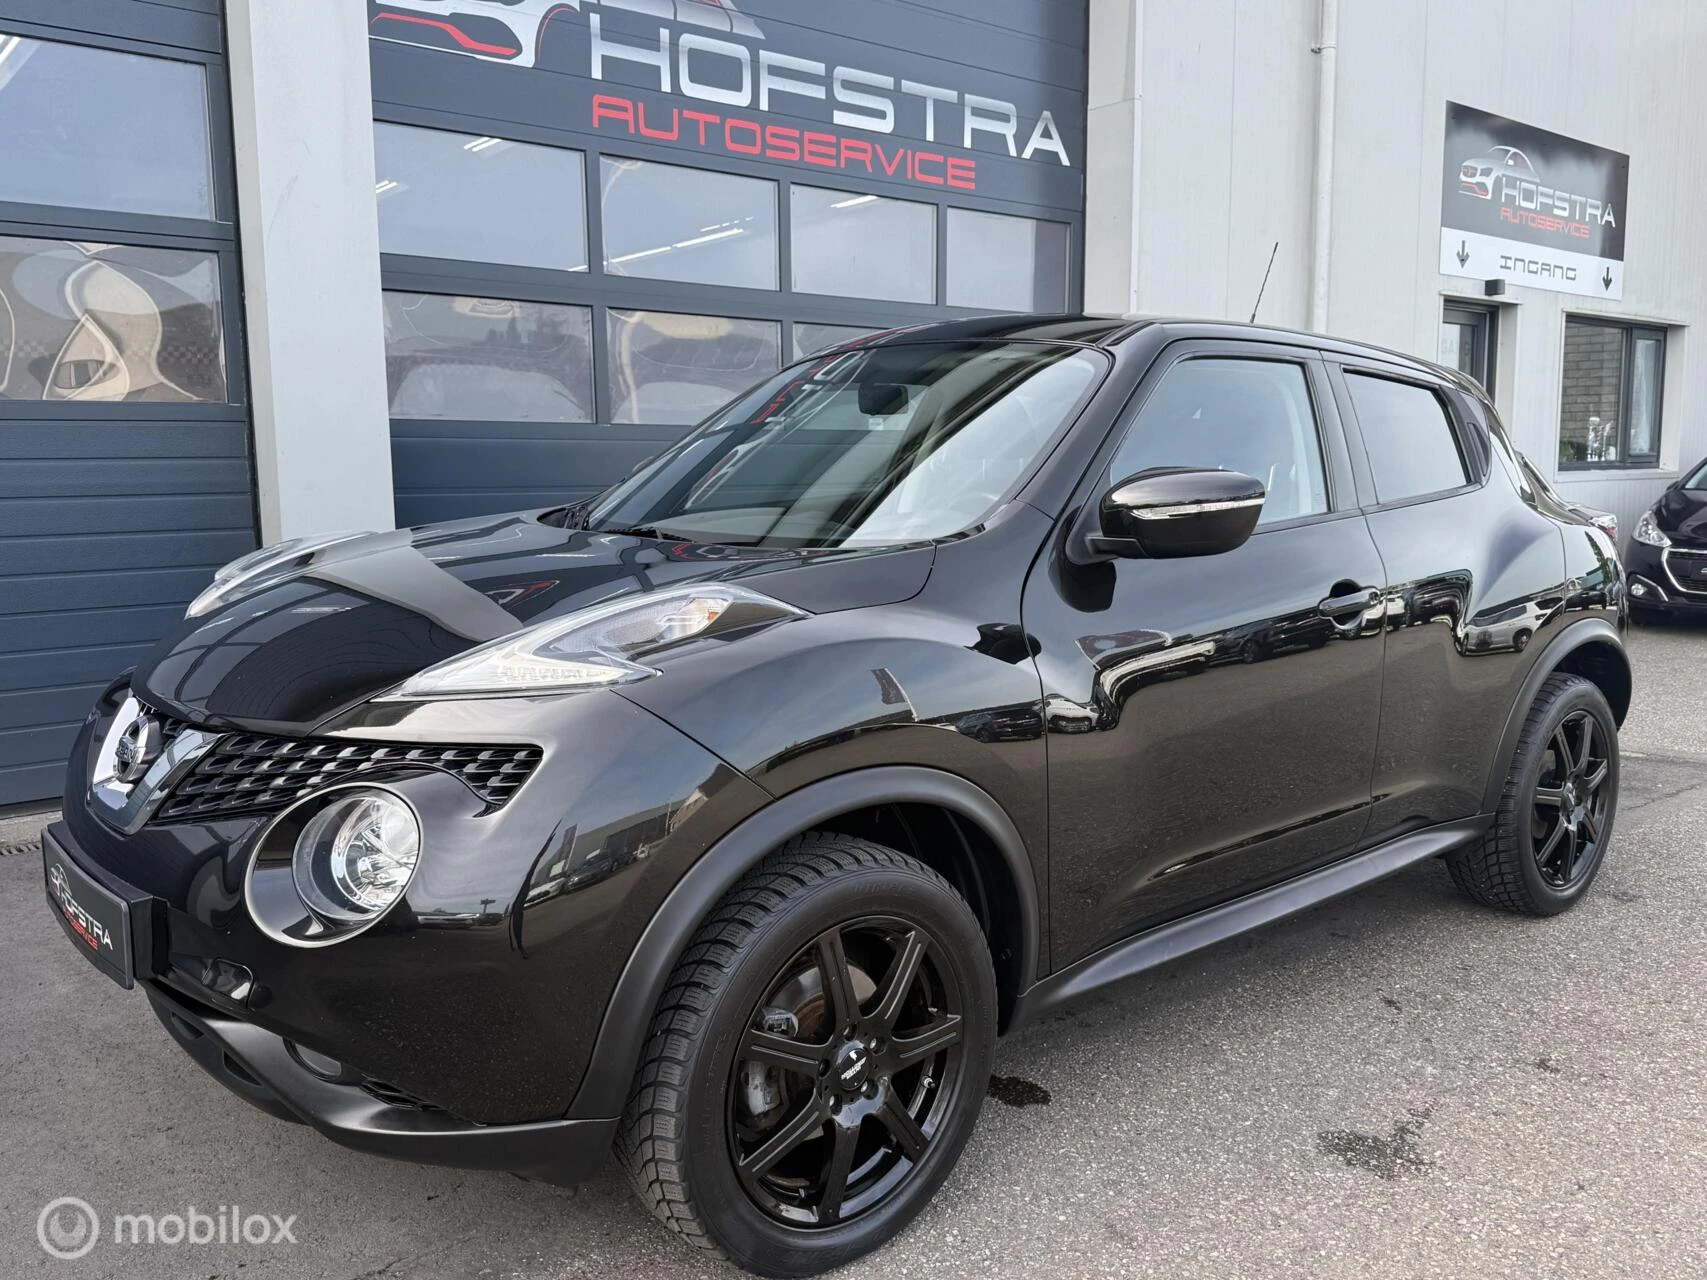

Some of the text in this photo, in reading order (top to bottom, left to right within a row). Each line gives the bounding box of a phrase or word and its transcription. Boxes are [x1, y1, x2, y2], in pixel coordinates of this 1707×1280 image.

[590, 13, 1070, 166] HOFSTRA
[592, 94, 976, 190] AUTOSERVICE
[1500, 207, 1590, 239] AUTOSERVICE
[1501, 177, 1616, 228] HOFSTRA
[1499, 255, 1577, 281] INGANG
